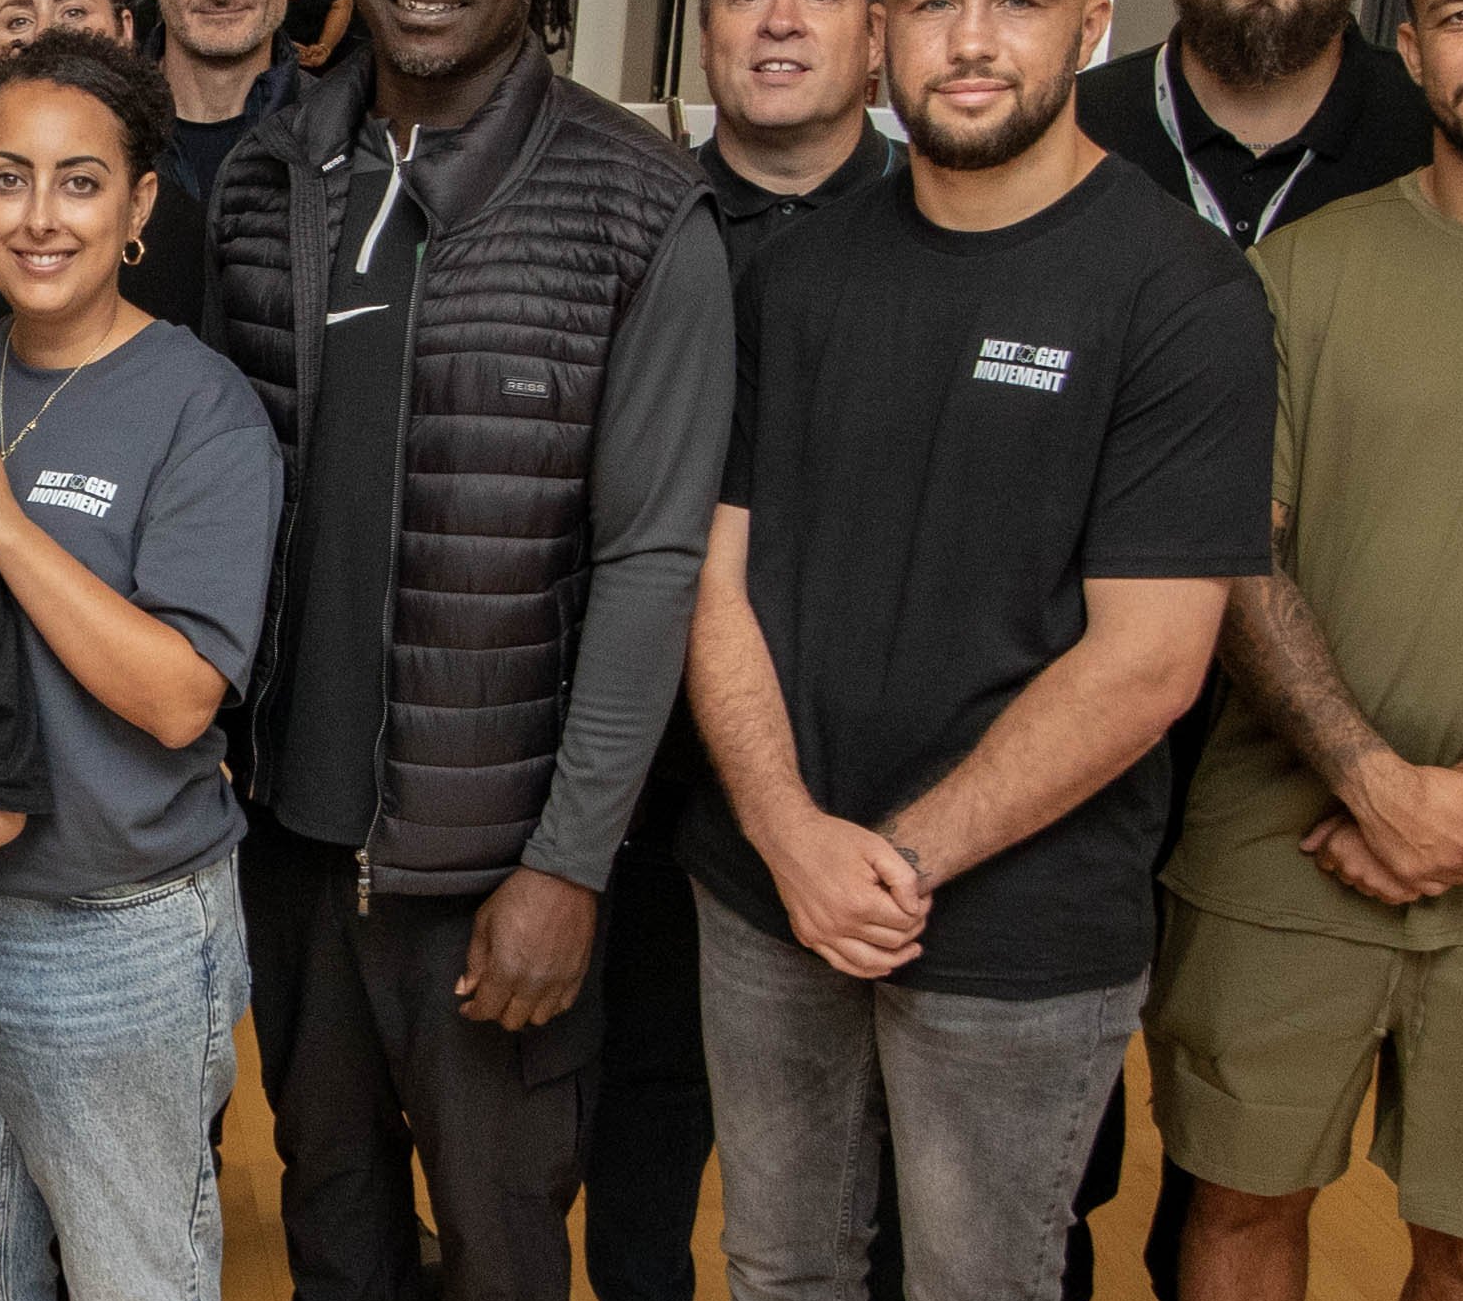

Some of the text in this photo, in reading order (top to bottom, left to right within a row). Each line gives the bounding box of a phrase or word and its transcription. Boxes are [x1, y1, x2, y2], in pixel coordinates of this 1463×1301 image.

[979, 338, 1073, 371] NEXT GEN
[507, 381, 547, 393] REISS
[973, 360, 1068, 393] MOVEMENT
[36, 470, 118, 501] NEXT GEN
[26, 486, 112, 518] MOVEMENT
